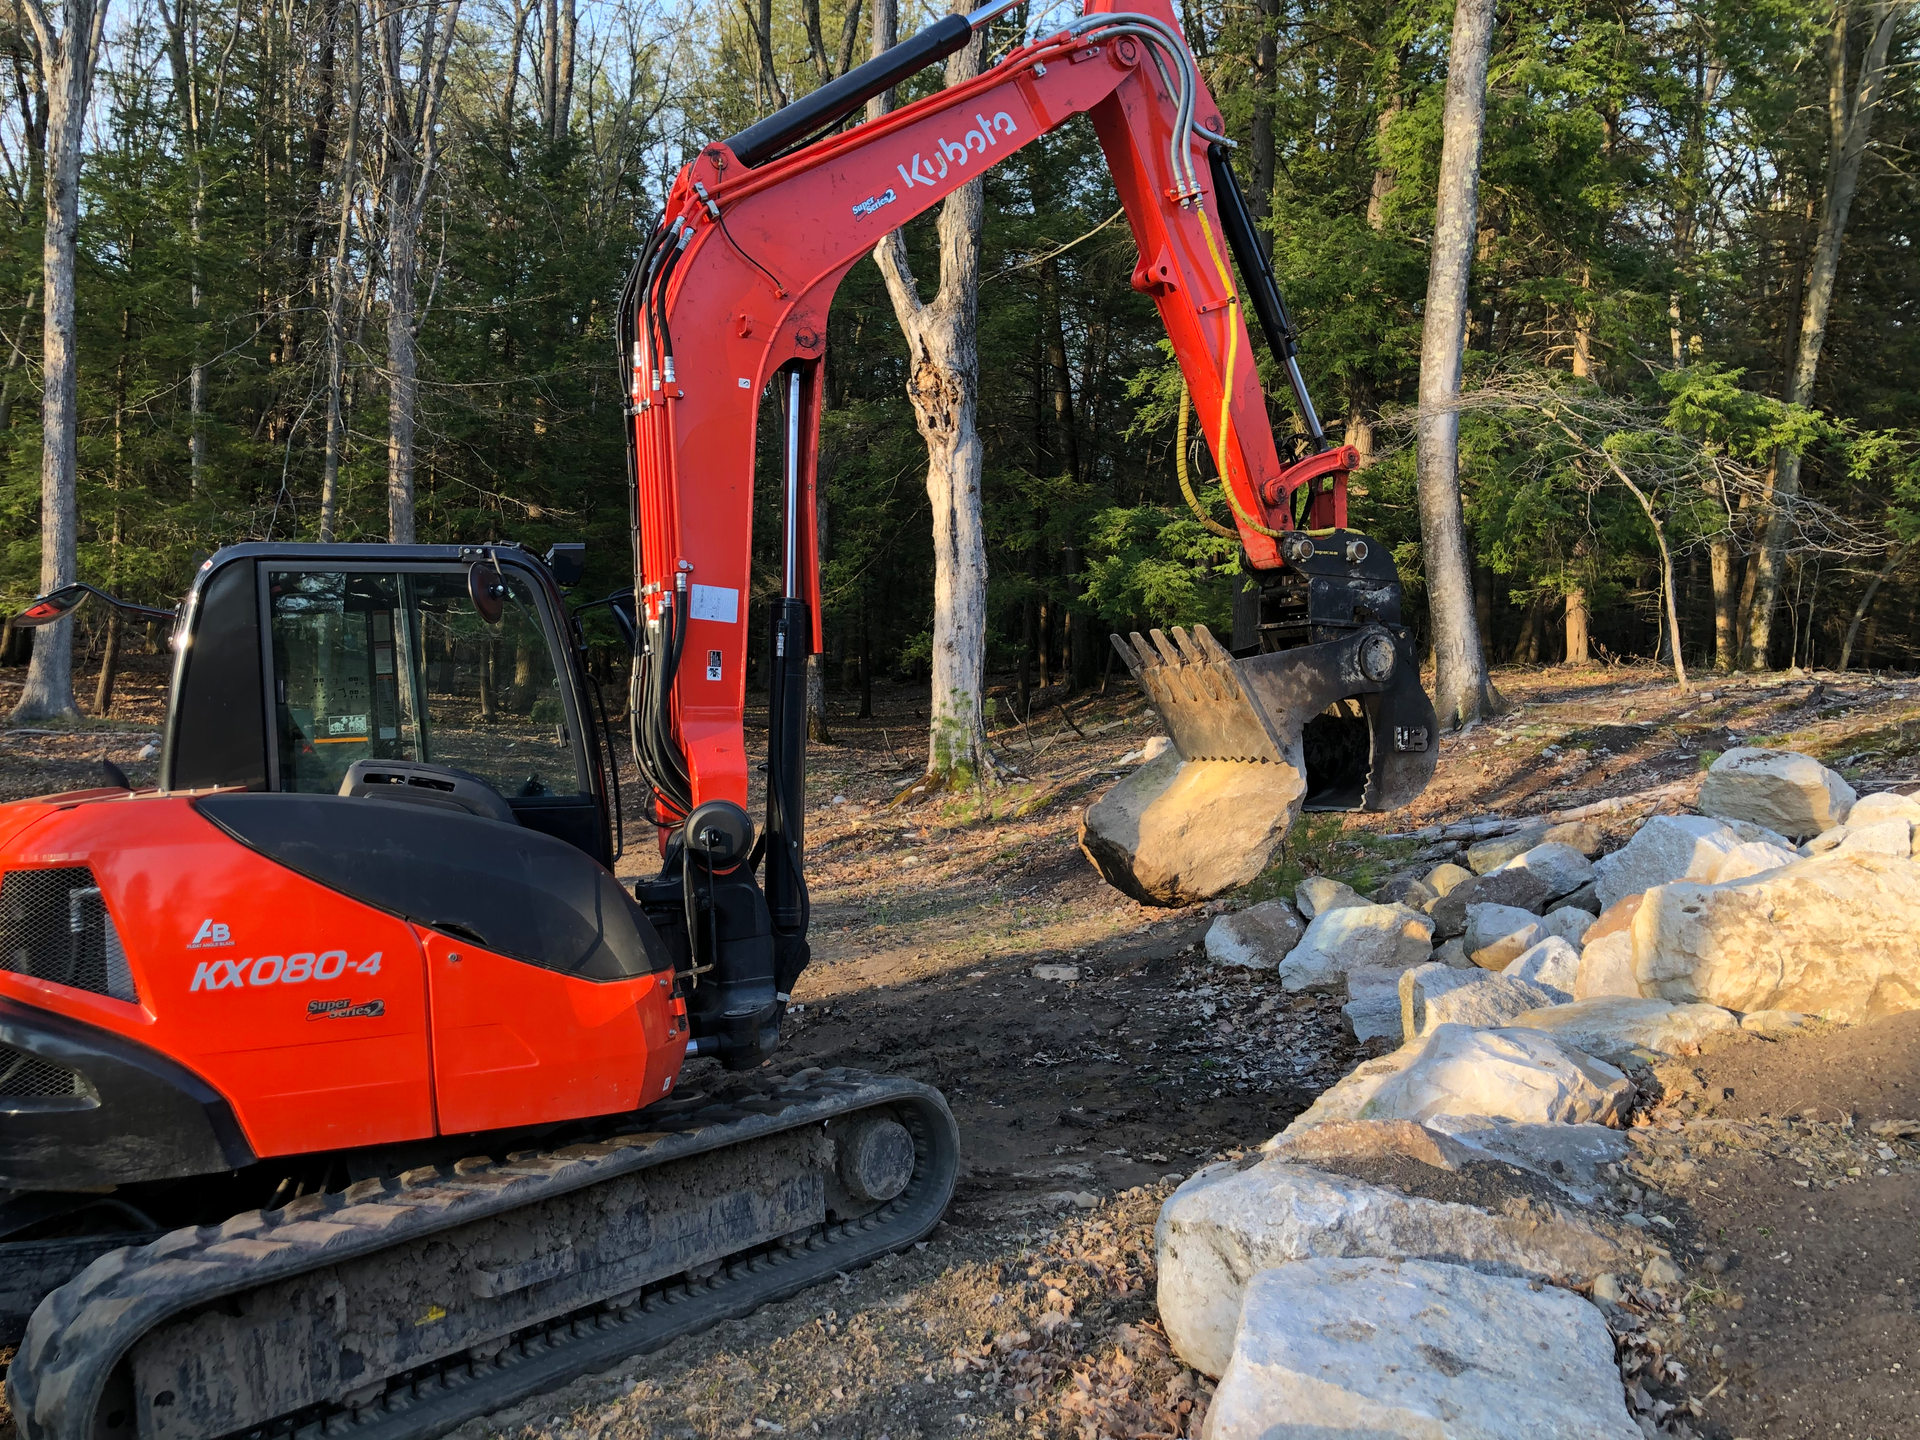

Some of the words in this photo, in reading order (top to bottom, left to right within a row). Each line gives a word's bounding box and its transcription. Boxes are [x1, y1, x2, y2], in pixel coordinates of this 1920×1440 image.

[897, 111, 1018, 188] Kubota
[852, 196, 874, 215] Super
[190, 950, 383, 992] KX080-4
[309, 999, 350, 1011] Super
